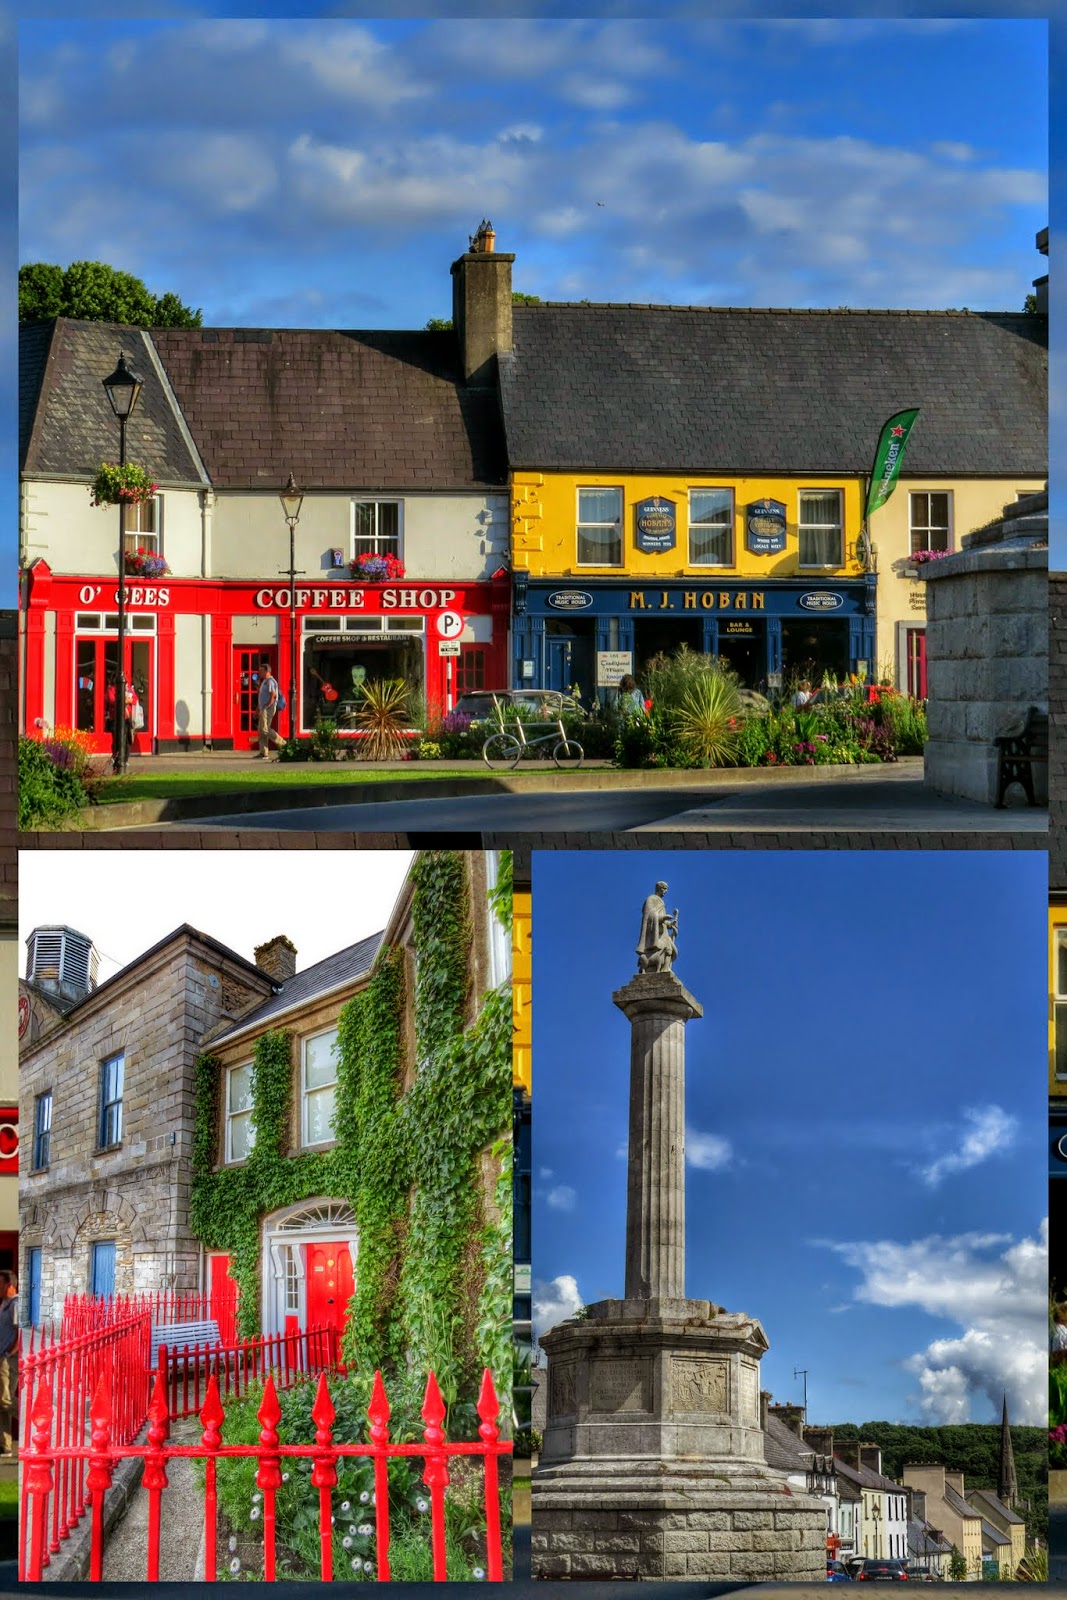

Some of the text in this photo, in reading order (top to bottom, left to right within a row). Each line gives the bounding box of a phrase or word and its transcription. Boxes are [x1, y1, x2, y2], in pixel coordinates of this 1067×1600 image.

[79, 585, 101, 604] O'
[256, 589, 456, 608] COFFEE SHOP
[630, 591, 765, 609] M. J. HOBAN
